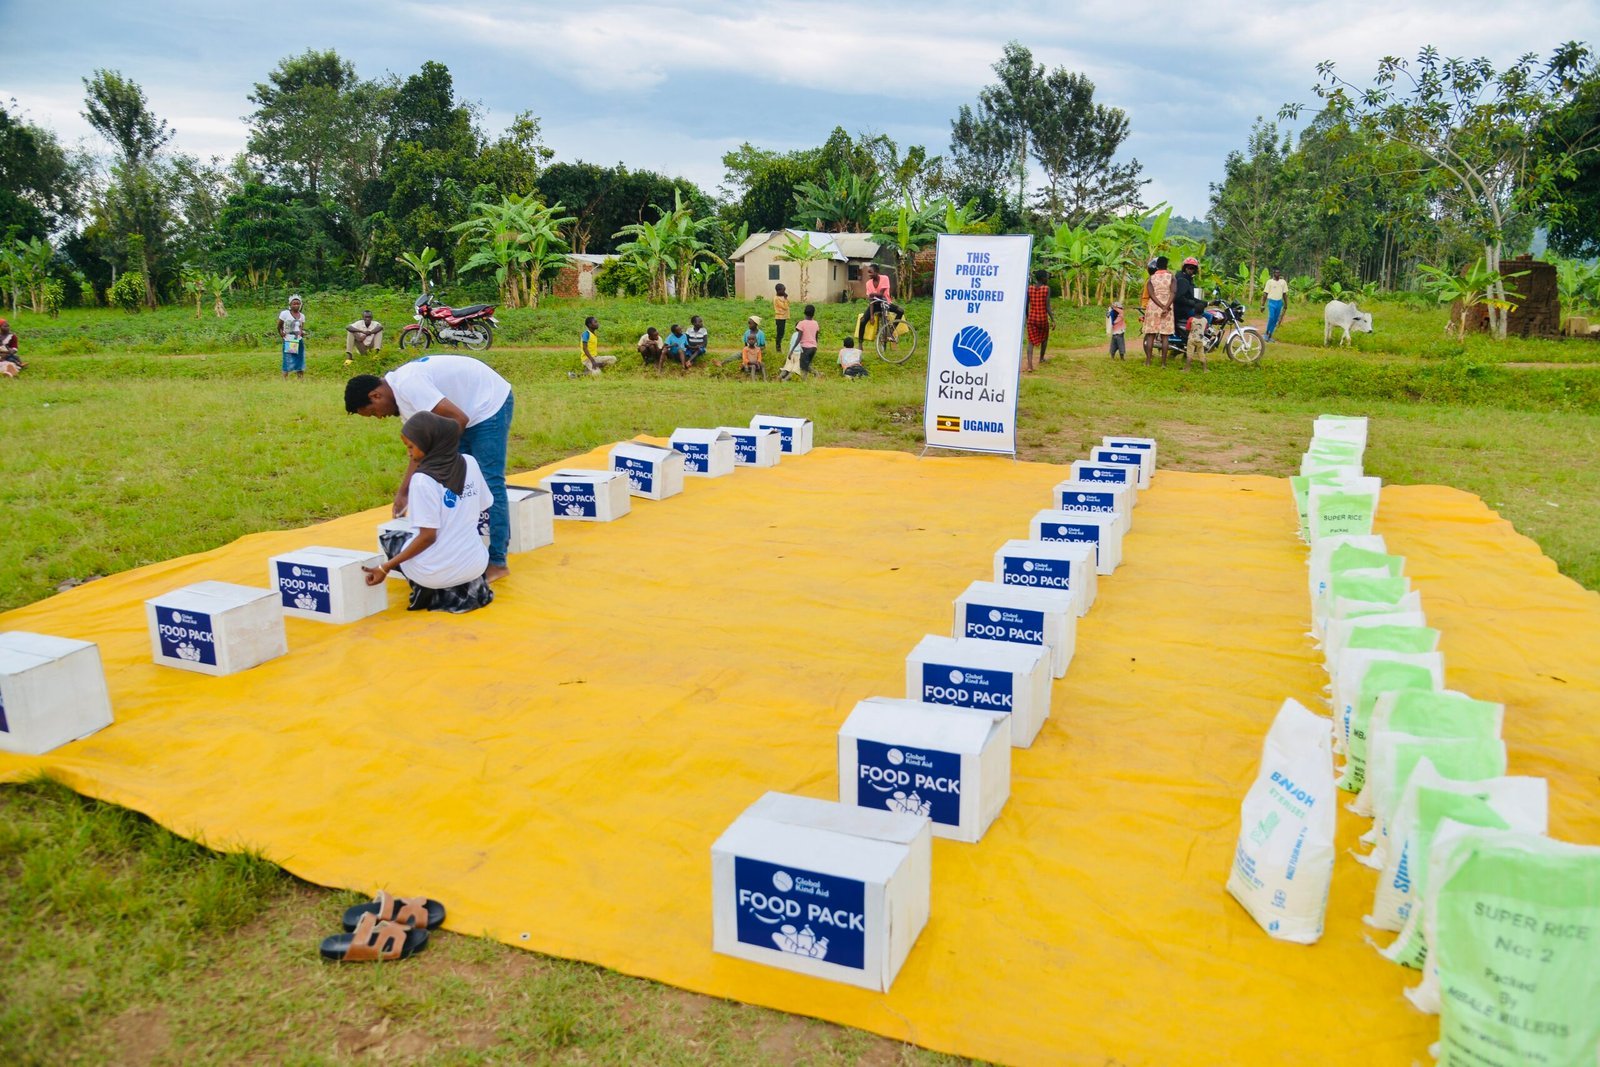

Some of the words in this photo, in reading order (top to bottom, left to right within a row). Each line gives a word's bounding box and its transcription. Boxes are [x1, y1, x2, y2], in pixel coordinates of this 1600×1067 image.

[967, 252, 990, 264] THIS
[956, 265, 999, 276] PROJECT
[971, 277, 981, 288] IS
[945, 290, 1004, 302] SPONSORED
[967, 303, 980, 314] BY
[940, 370, 988, 386] Global
[938, 386, 973, 400] Kind
[978, 388, 1005, 402] Aid
[964, 420, 1004, 434] UGANDA
[636, 470, 653, 480] PACK
[280, 578, 306, 589] FOOD
[308, 582, 330, 593] PACK
[1005, 573, 1038, 584] FOOD
[1040, 576, 1069, 587] PACK
[160, 624, 187, 638] FOOD
[188, 629, 214, 642] PACK
[967, 622, 1005, 637] FOOD
[1009, 628, 1042, 642] PACK
[925, 685, 969, 701] FOOD
[973, 691, 1012, 707] PACK
[906, 752, 926, 760] Global
[860, 764, 910, 785] FOOD
[915, 774, 960, 794] PACK
[795, 877, 821, 888] Global
[795, 884, 814, 894] Kind
[816, 888, 830, 898] Aid
[739, 889, 801, 917] FOOD
[808, 904, 864, 931] PACK
[1474, 902, 1538, 932] SUPER
[1544, 922, 1590, 941] RICE
[1540, 948, 1554, 963] 2
[1498, 1012, 1569, 1038] MILLERS
